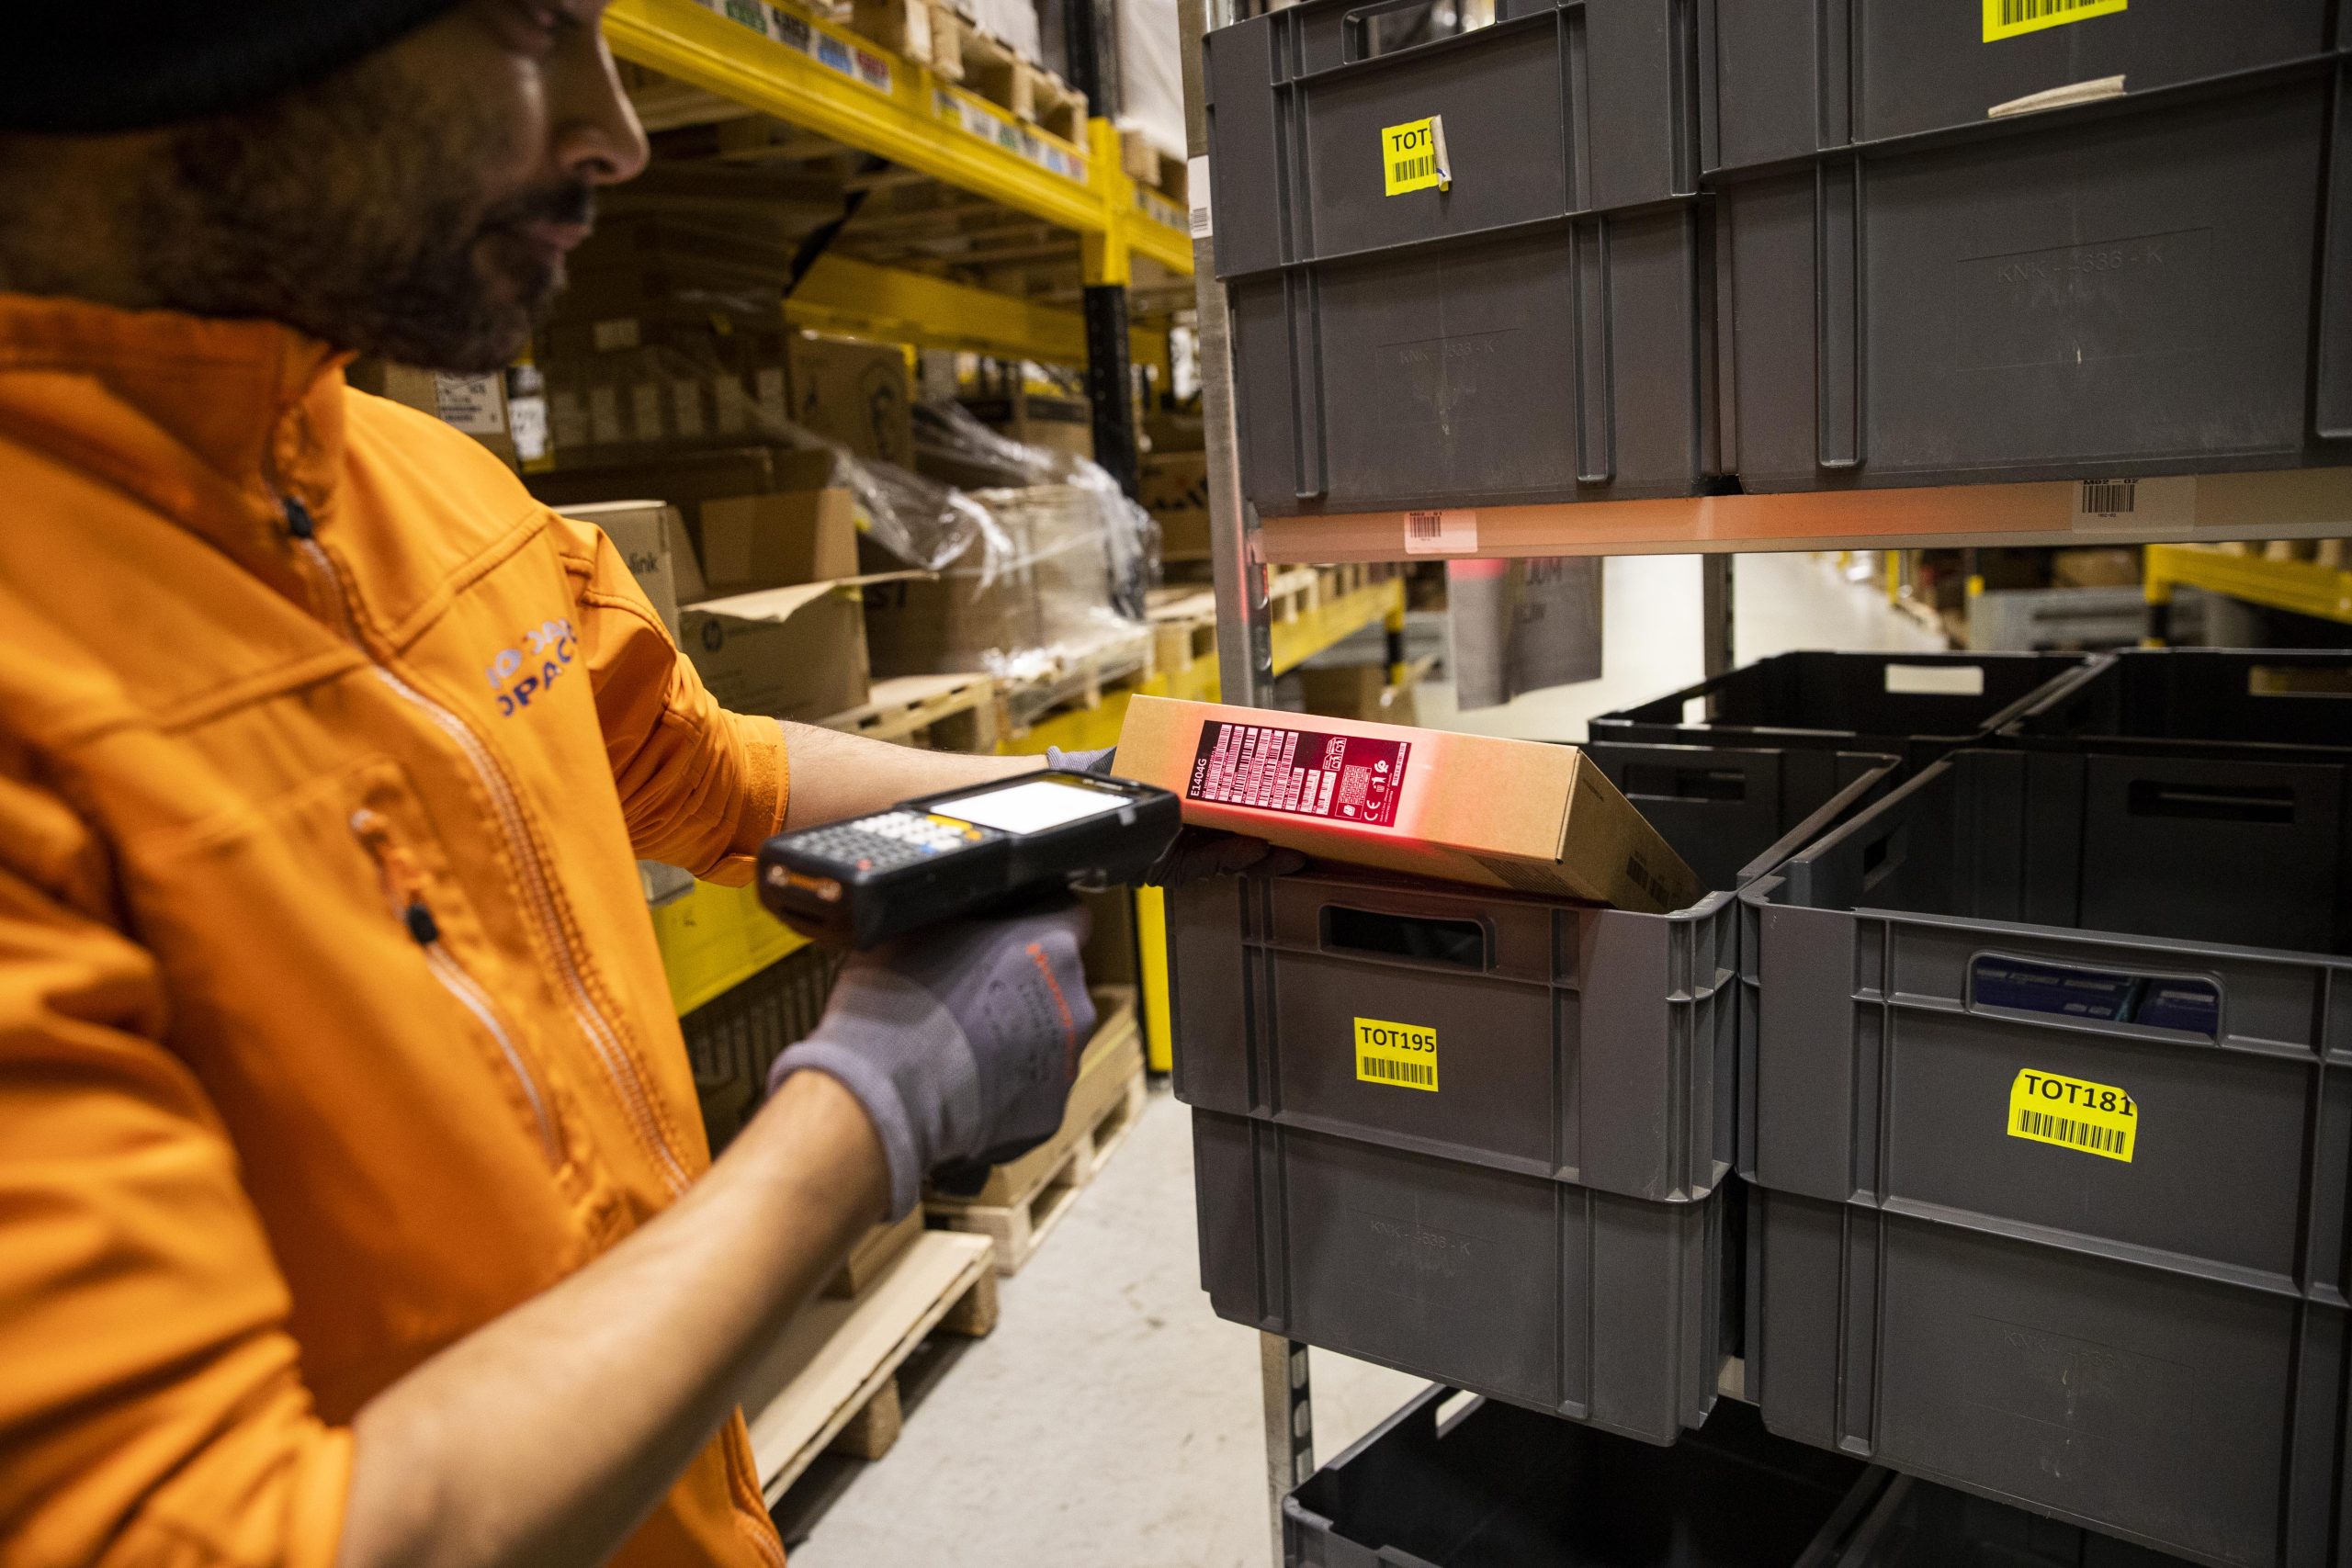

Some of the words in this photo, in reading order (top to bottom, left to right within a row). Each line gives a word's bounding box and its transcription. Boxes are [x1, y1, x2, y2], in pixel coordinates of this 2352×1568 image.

[1392, 128, 1433, 152] TOT
[1191, 758, 1207, 796] E1404G
[1361, 1026, 1435, 1053] TOT195
[2025, 1074, 2133, 1117] TOT181
